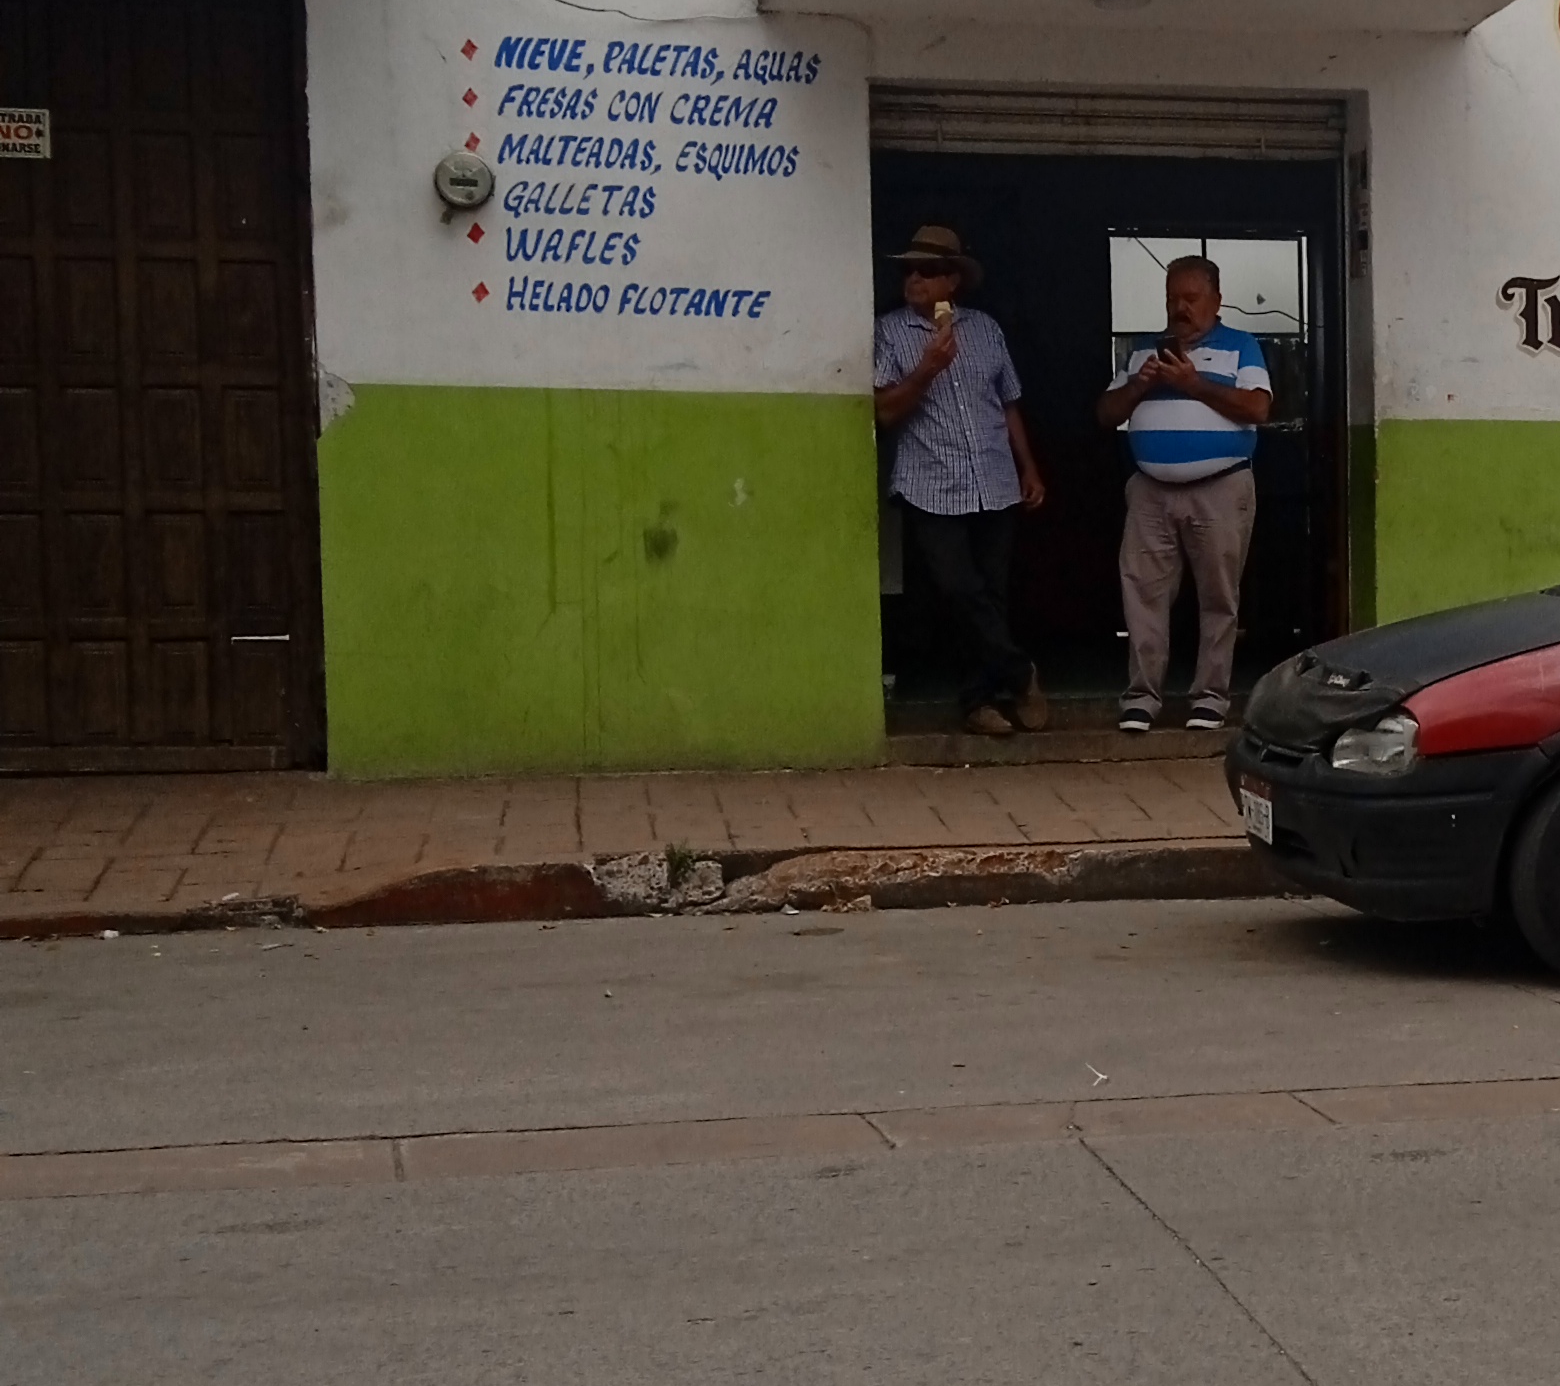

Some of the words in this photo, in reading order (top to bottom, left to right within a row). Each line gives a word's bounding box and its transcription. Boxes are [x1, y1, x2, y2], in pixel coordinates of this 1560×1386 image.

[494, 36, 595, 78] NIEVE,
[603, 41, 724, 85] PALETAS,
[732, 48, 822, 85] AGUAS
[498, 84, 598, 121] FRESAS
[607, 90, 664, 124] CON
[669, 93, 778, 129] CREMA
[497, 133, 662, 175] MALTEADAS,
[675, 140, 800, 181] ESQUIMOS
[502, 180, 657, 219] GALLETAS
[505, 226, 642, 266] WAFLES
[506, 275, 611, 314] HELADO
[617, 282, 771, 319] FLOTANTE
